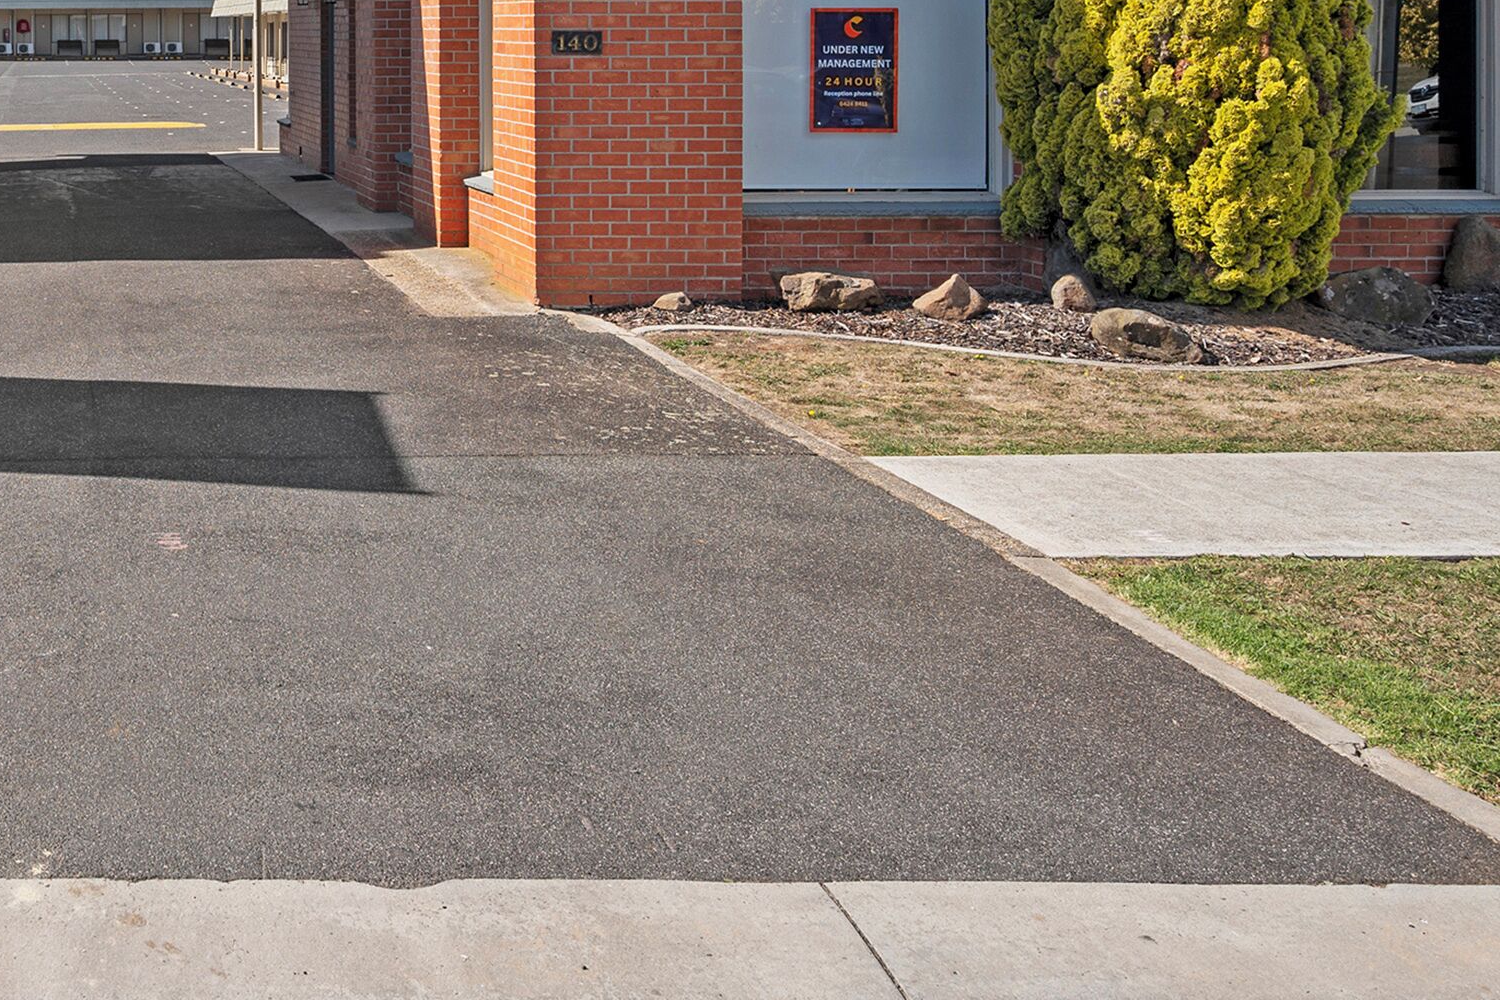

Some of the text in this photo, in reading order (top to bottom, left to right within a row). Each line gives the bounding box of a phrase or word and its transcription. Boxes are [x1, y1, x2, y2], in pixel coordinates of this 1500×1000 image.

[557, 34, 598, 51] 140
[822, 45, 884, 54] UNDER NEW
[818, 59, 892, 68] MANAGEMENT
[825, 77, 883, 86] 24 HOUR
[823, 90, 853, 98] Reception
[853, 90, 872, 98] phone
